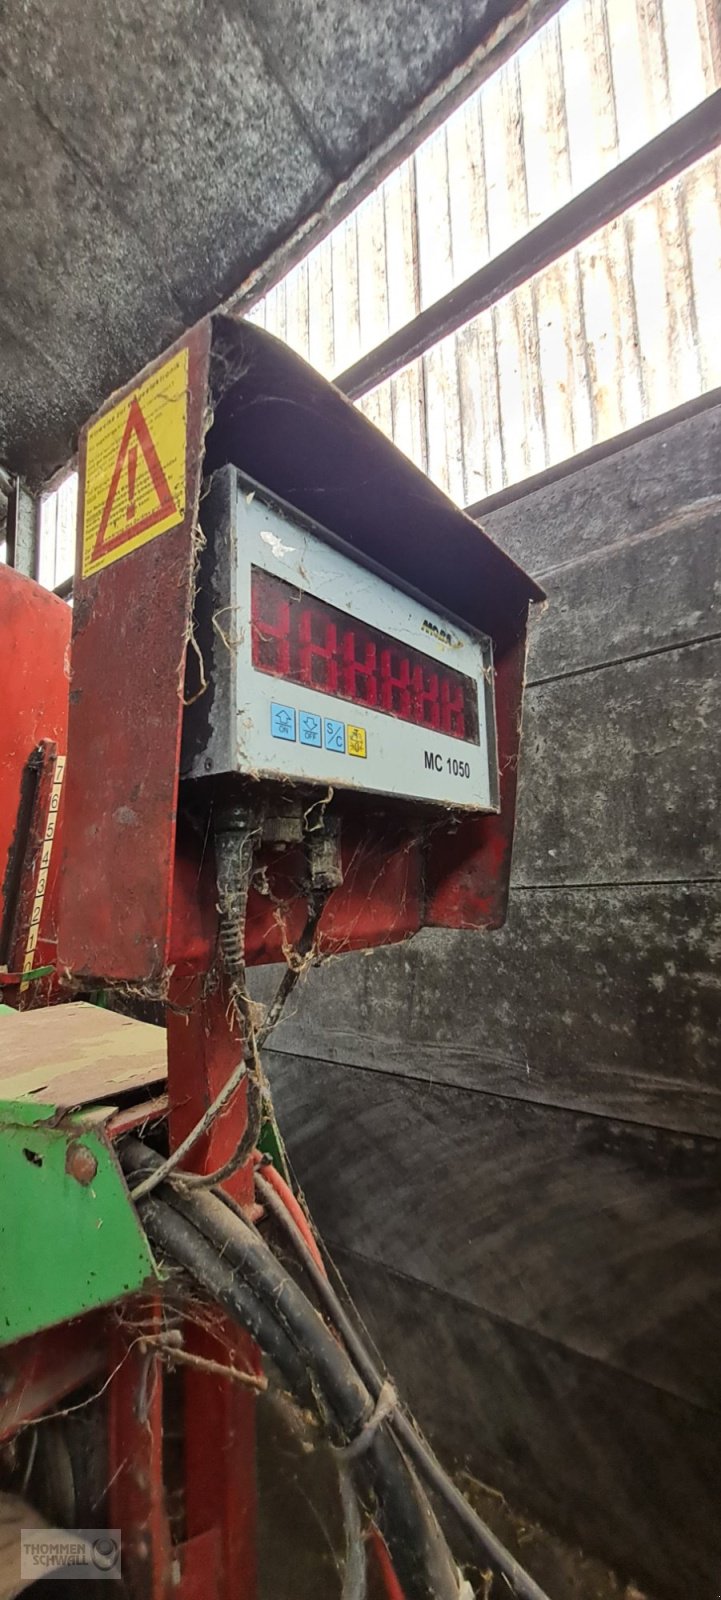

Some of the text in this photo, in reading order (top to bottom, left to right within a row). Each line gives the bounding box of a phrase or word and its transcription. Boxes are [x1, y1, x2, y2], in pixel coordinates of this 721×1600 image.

[278, 726, 289, 734] ON
[304, 732, 317, 740] OFF
[55, 765, 64, 781] 7
[424, 750, 471, 780] MC 1050
[51, 793, 59, 809] 6
[46, 822, 54, 838] 5
[41, 850, 49, 865] 4
[37, 878, 45, 894] 3
[32, 906, 41, 922] 2
